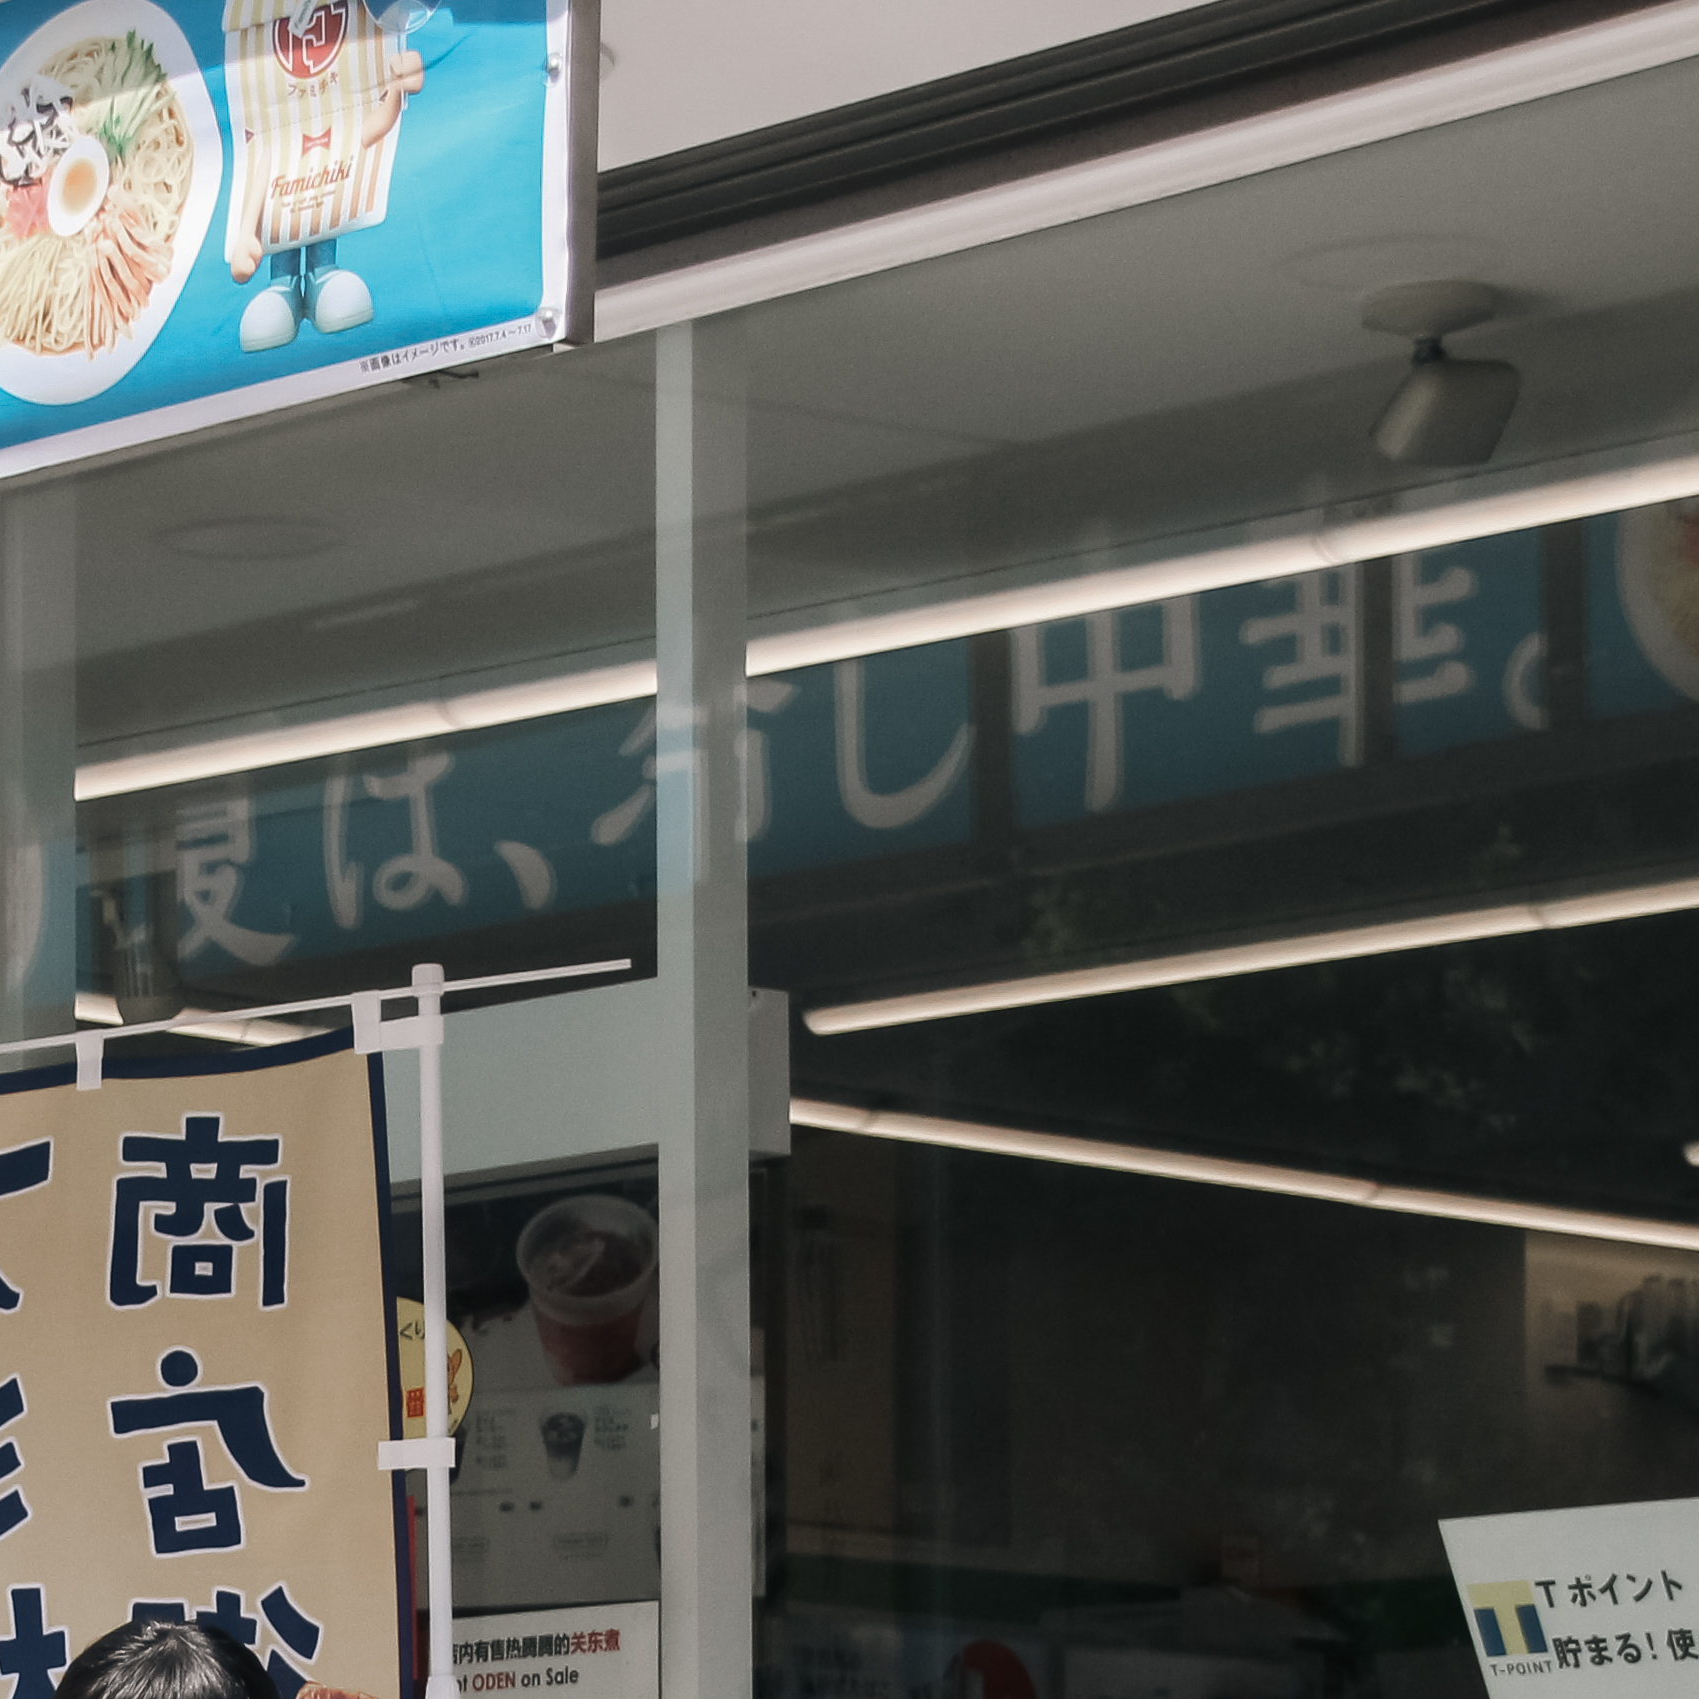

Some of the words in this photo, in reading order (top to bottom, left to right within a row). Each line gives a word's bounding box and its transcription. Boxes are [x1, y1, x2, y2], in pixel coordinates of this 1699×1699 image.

[271, 155, 354, 199] Famichiki
[472, 1671, 516, 1692] ODEN
[521, 1673, 541, 1687] on
[546, 1666, 579, 1686] Sale
[1490, 1659, 1553, 1676] T-POINT
